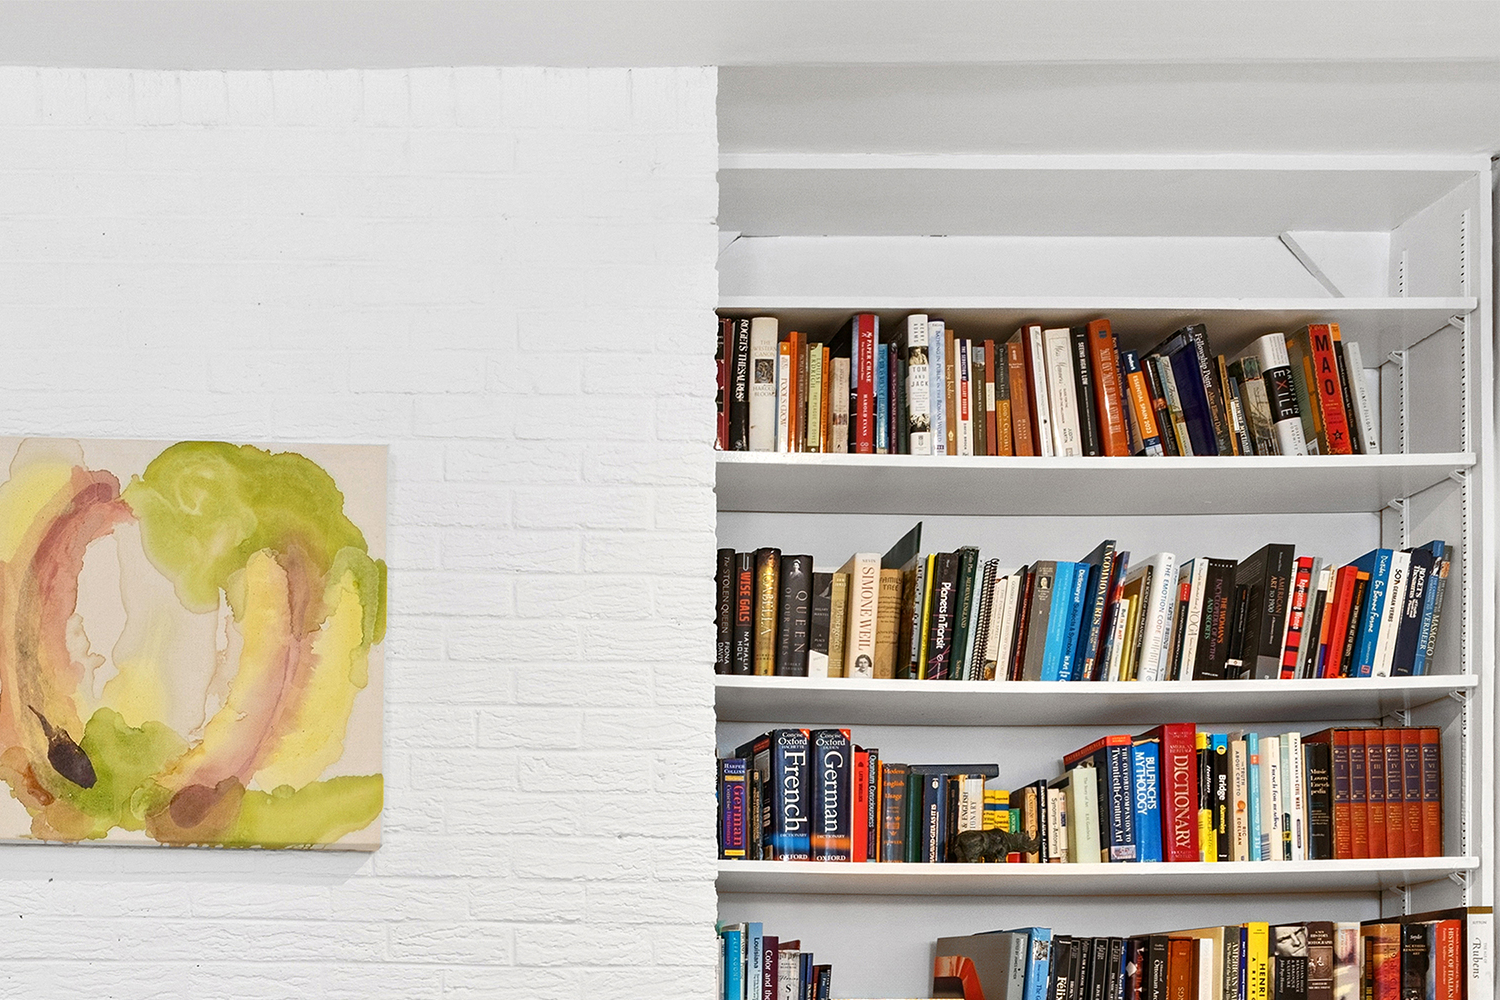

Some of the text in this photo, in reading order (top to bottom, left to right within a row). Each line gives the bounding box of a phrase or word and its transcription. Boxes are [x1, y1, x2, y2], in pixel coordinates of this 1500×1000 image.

[1195, 333, 1213, 389] Fellowship Point
[1315, 335, 1335, 396] MAO
[1132, 375, 1152, 434] ESSENTIAL SPAIN 2023
[1273, 369, 1293, 417] EXILE
[722, 569, 730, 603] STOLEN
[739, 572, 751, 622] WISE GALS
[760, 572, 775, 635] ISABELLA
[858, 566, 875, 651] SIMONE WEIL
[1093, 545, 1114, 625] UNCOMMON CURES
[1155, 564, 1172, 634] THE EMOTION CODE
[1275, 576, 1285, 614] AMERICAN
[1293, 579, 1308, 630] Representing Women
[1387, 586, 1398, 623] GERMAN VERBS
[720, 604, 729, 634] QUEEN
[782, 587, 791, 656] OF OUR TIMES
[793, 590, 808, 653] QUEEN
[936, 582, 952, 649] Planets in Transit
[1204, 614, 1213, 640] SECRETS
[1217, 597, 1228, 644] THE WOMAN'S
[1419, 612, 1431, 650] VERMEER
[1426, 614, 1440, 656] MASACCIO
[742, 631, 750, 671] NATHALIA
[778, 737, 808, 746] Oxford
[816, 737, 846, 747] Oxford
[784, 750, 808, 833] French
[824, 750, 843, 833] German
[868, 755, 876, 828] Quantum Consciousness
[1111, 748, 1124, 842] Twentieth-Century Art
[1135, 751, 1147, 815] MYTHOLOGY
[1145, 756, 1157, 810] BULFINCH'S
[1173, 754, 1191, 849] DICTIONARY
[1217, 774, 1226, 801] Bridge
[725, 811, 733, 846] Dictionary
[733, 785, 744, 846] German
[1125, 834, 1131, 842] TO
[764, 950, 773, 970] Color
[765, 973, 773, 987] and
[1258, 963, 1266, 997] HENRI
[1447, 959, 1454, 969] OF
[1472, 937, 1482, 979] Rubens
